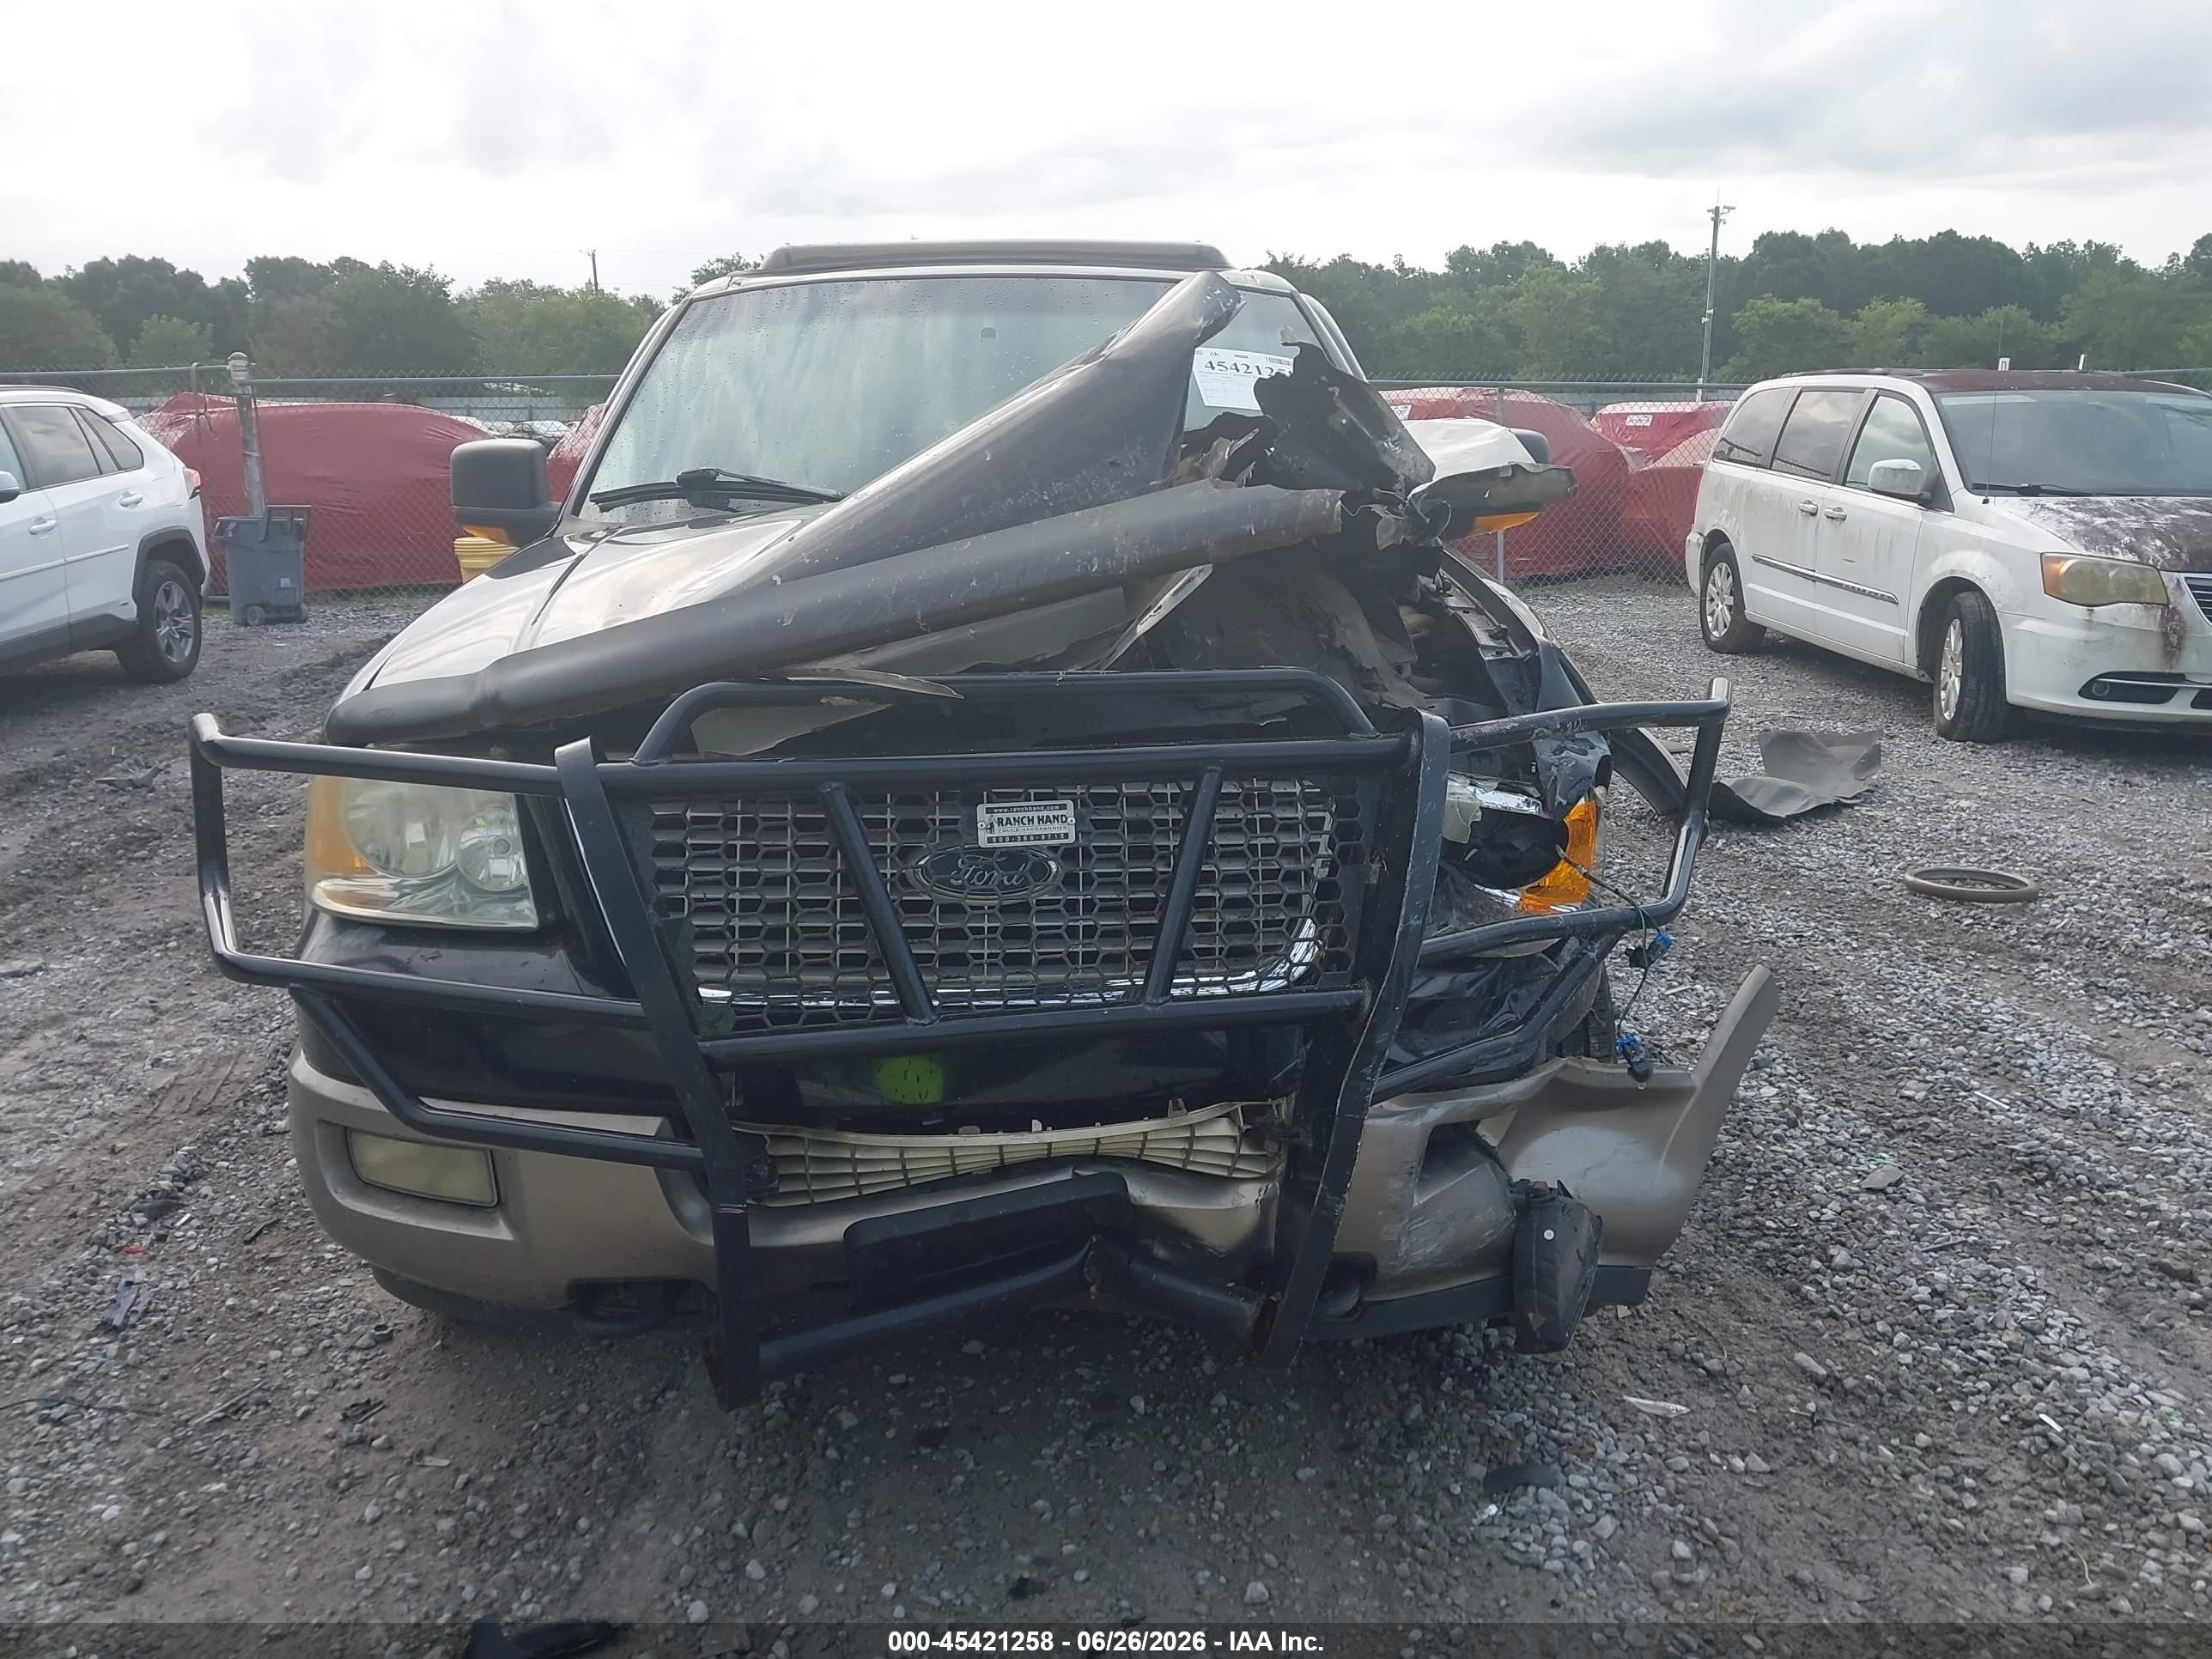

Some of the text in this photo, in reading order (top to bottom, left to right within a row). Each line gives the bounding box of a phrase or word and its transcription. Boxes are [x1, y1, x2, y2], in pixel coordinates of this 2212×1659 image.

[1204, 361, 1292, 377] 454212
[996, 814, 1067, 827] RANCH HAND
